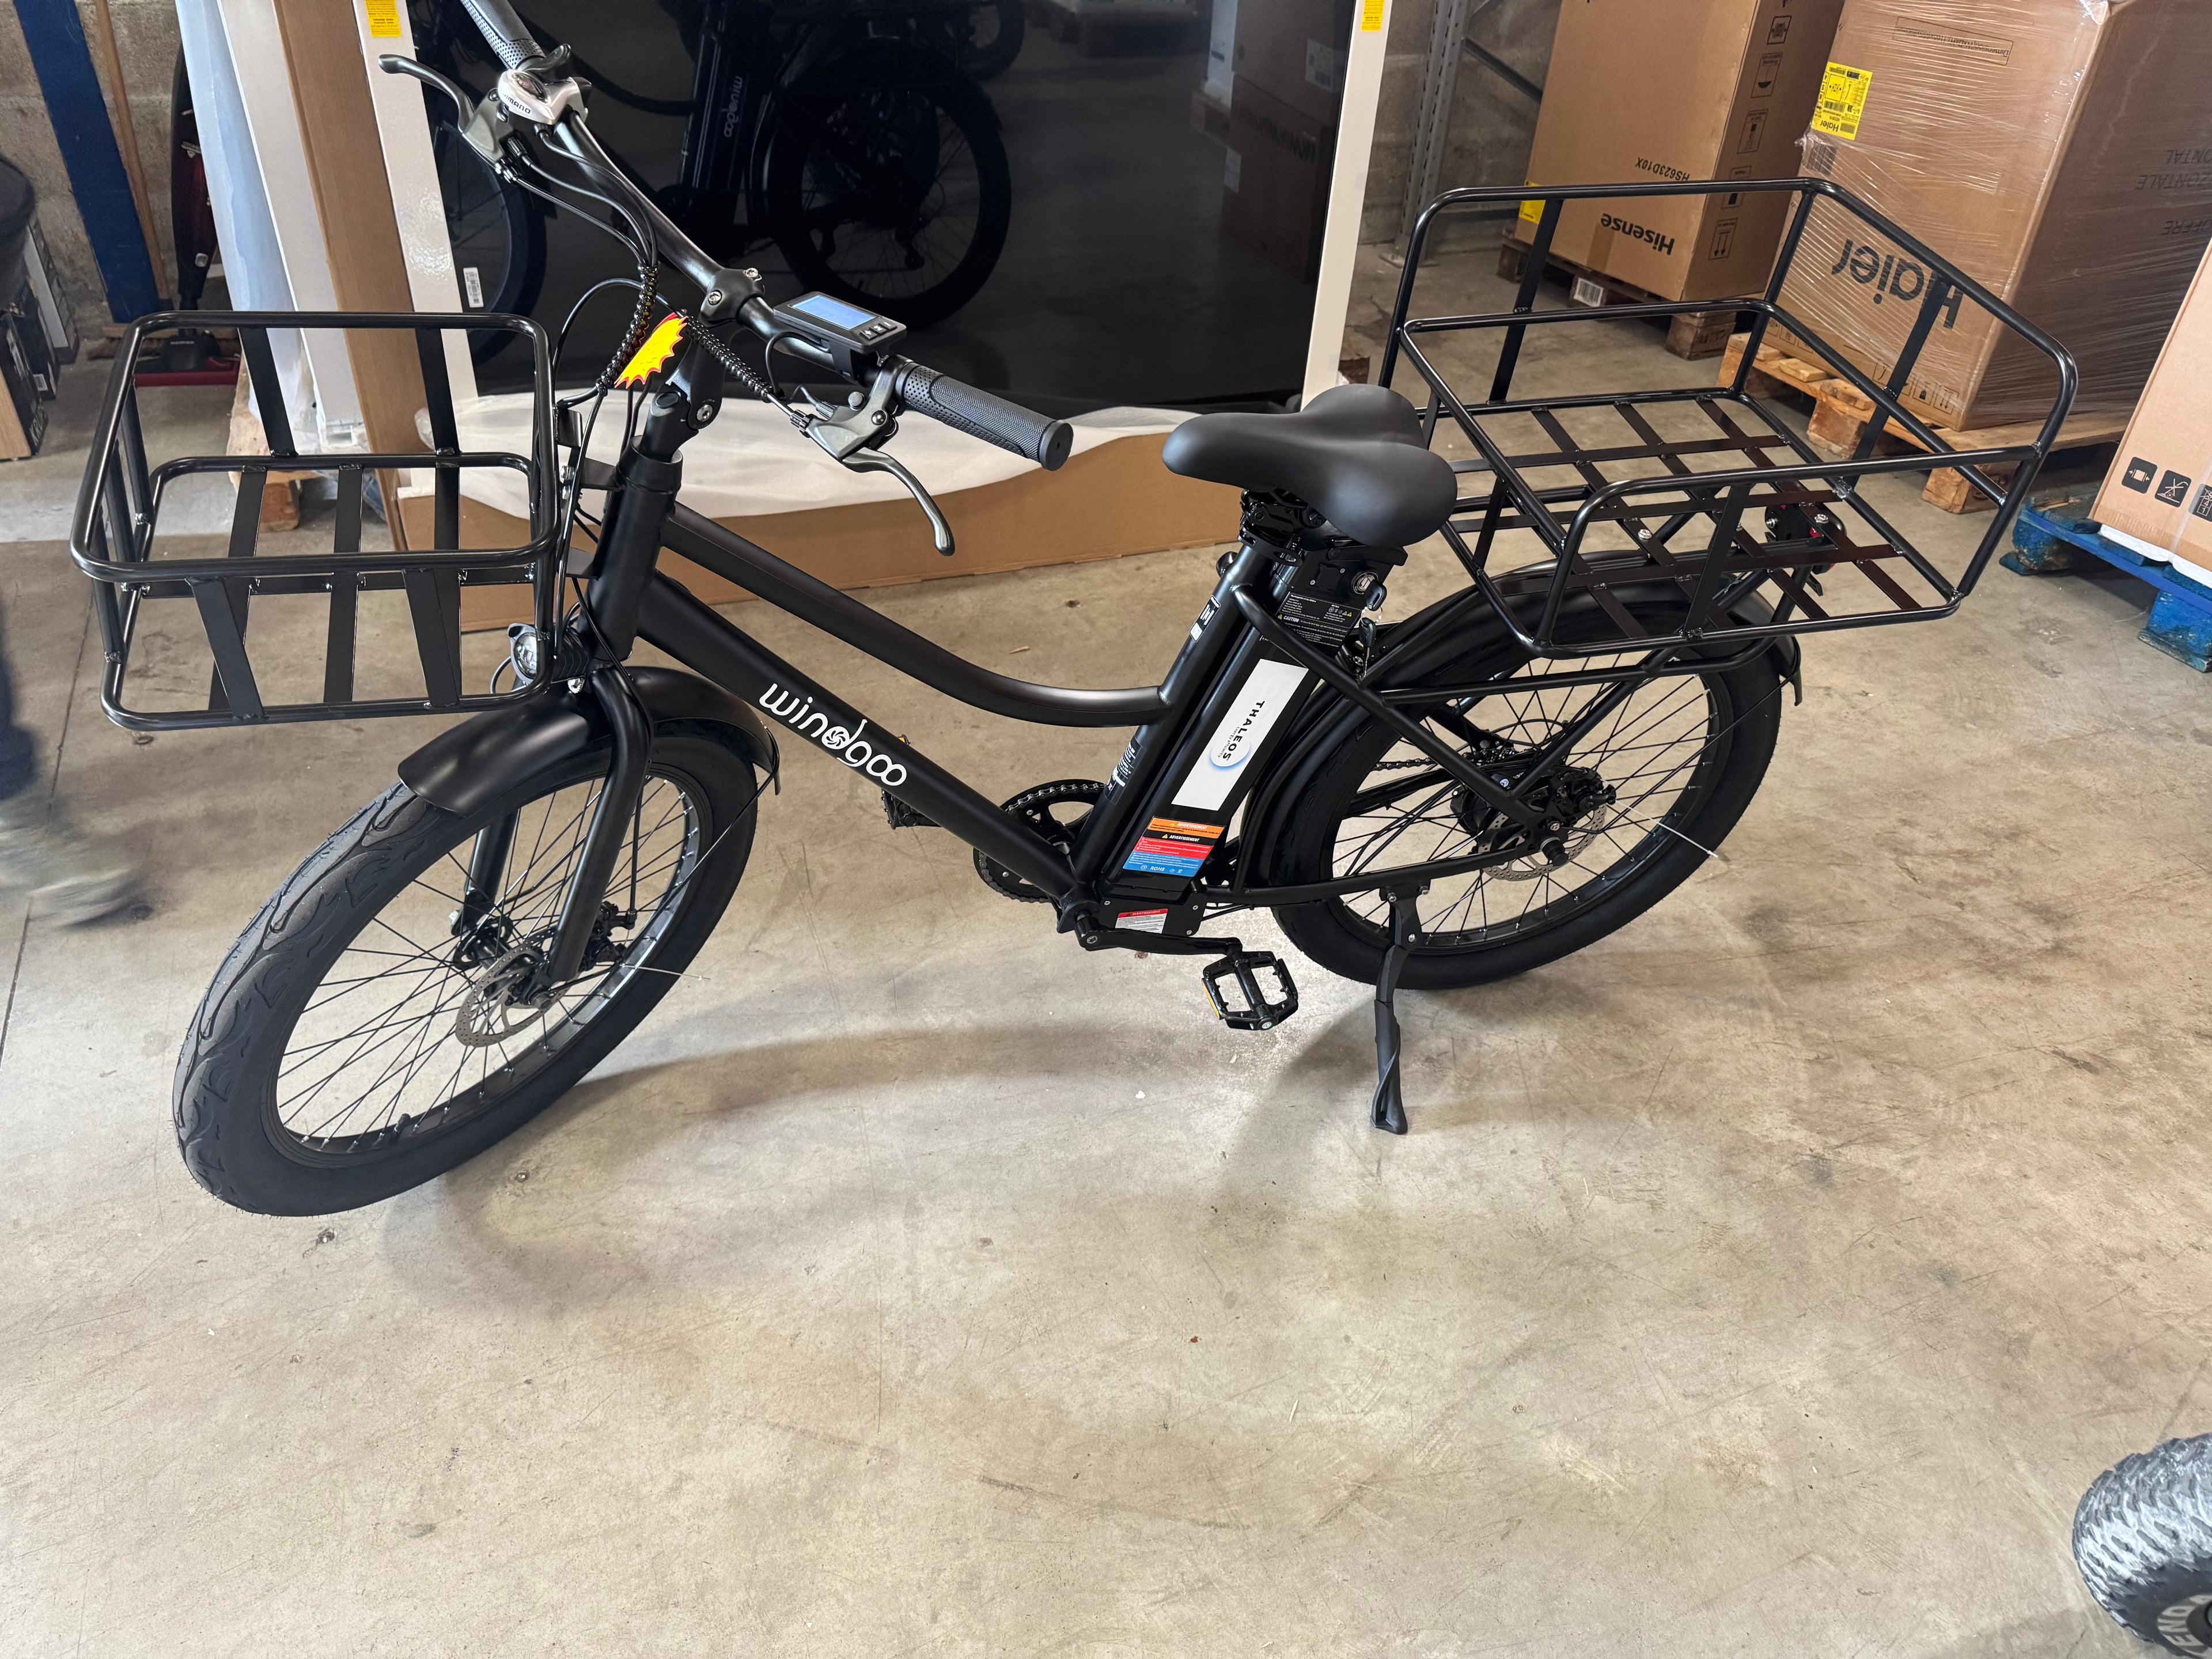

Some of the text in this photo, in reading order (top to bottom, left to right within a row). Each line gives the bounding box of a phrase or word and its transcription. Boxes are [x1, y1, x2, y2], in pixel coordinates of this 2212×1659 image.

[1820, 120, 1839, 132] Haier
[1601, 213, 1675, 255] Hisense
[759, 683, 908, 787] windgoo
[1223, 700, 1266, 760] THALEOS
